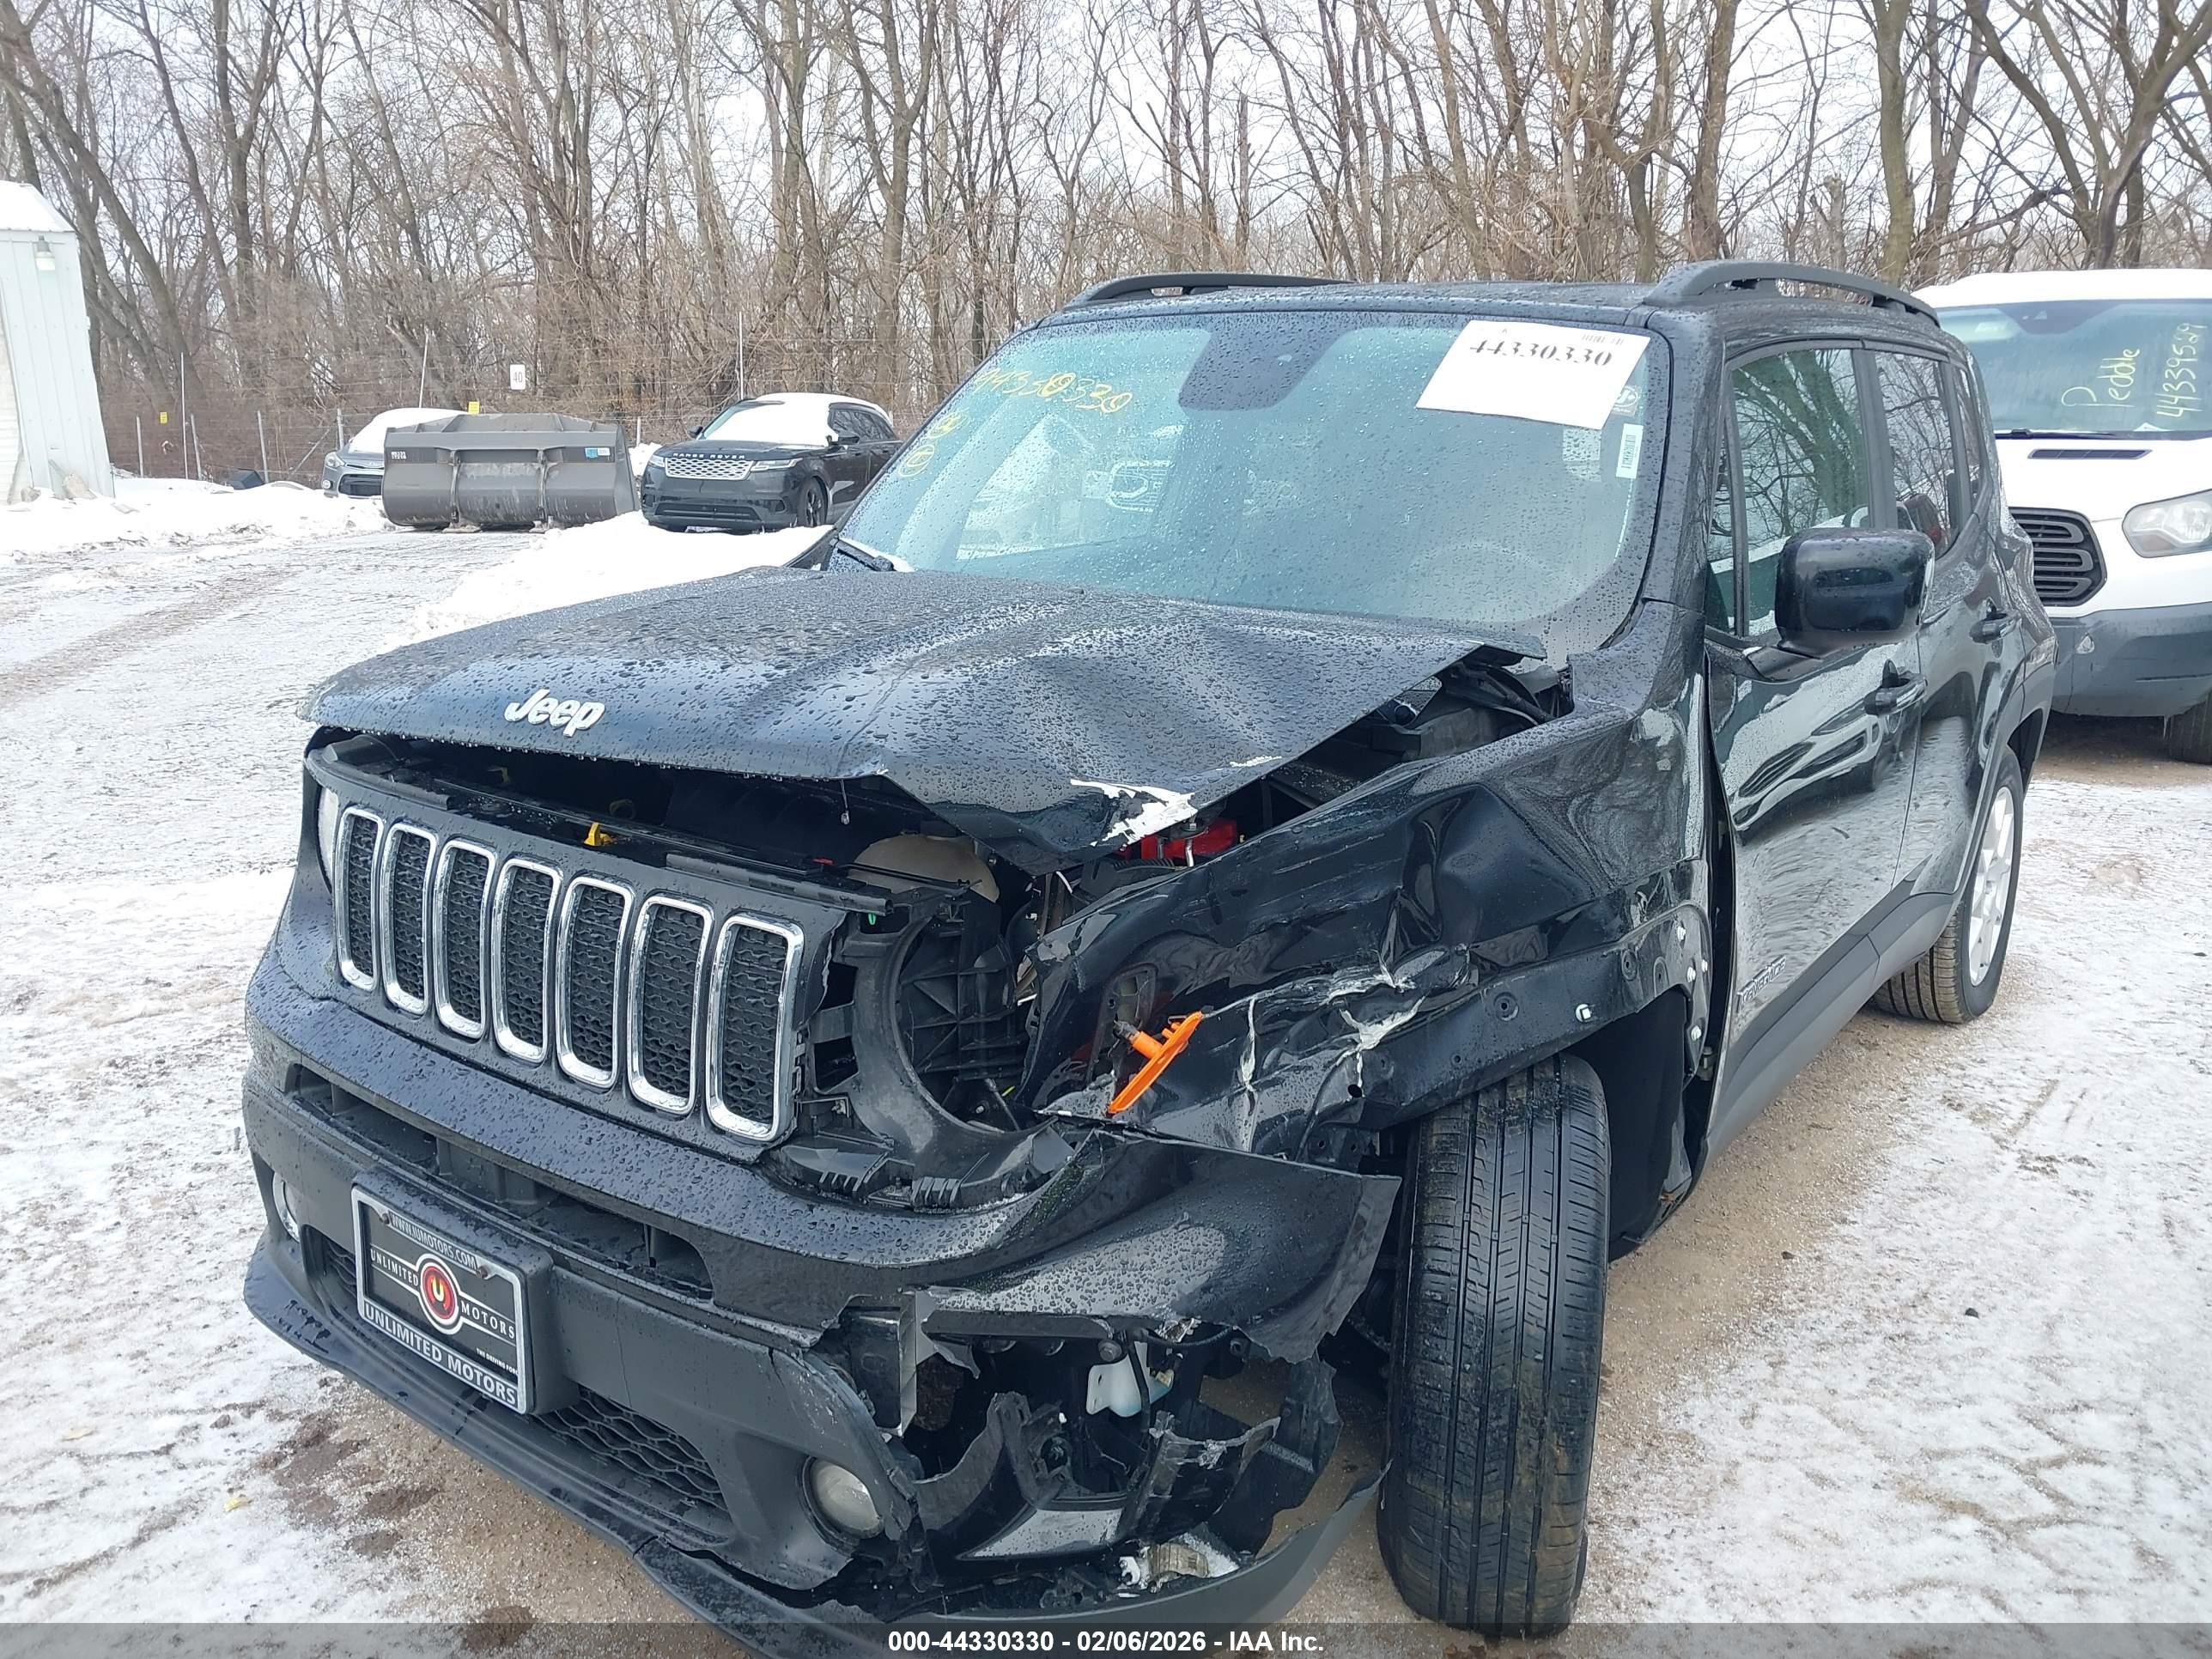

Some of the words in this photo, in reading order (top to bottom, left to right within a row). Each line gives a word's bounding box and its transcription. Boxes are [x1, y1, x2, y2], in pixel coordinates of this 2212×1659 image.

[1469, 340, 1613, 367] 44330330
[2061, 349, 2140, 407] Peddle
[2154, 323, 2209, 417] 44339529
[504, 689, 605, 738] Jeep
[370, 1249, 419, 1286] UNLIMITED
[460, 1300, 515, 1340] MOTORS
[364, 1302, 442, 1362] UNLIMITED
[447, 1353, 516, 1405] MOTORS
